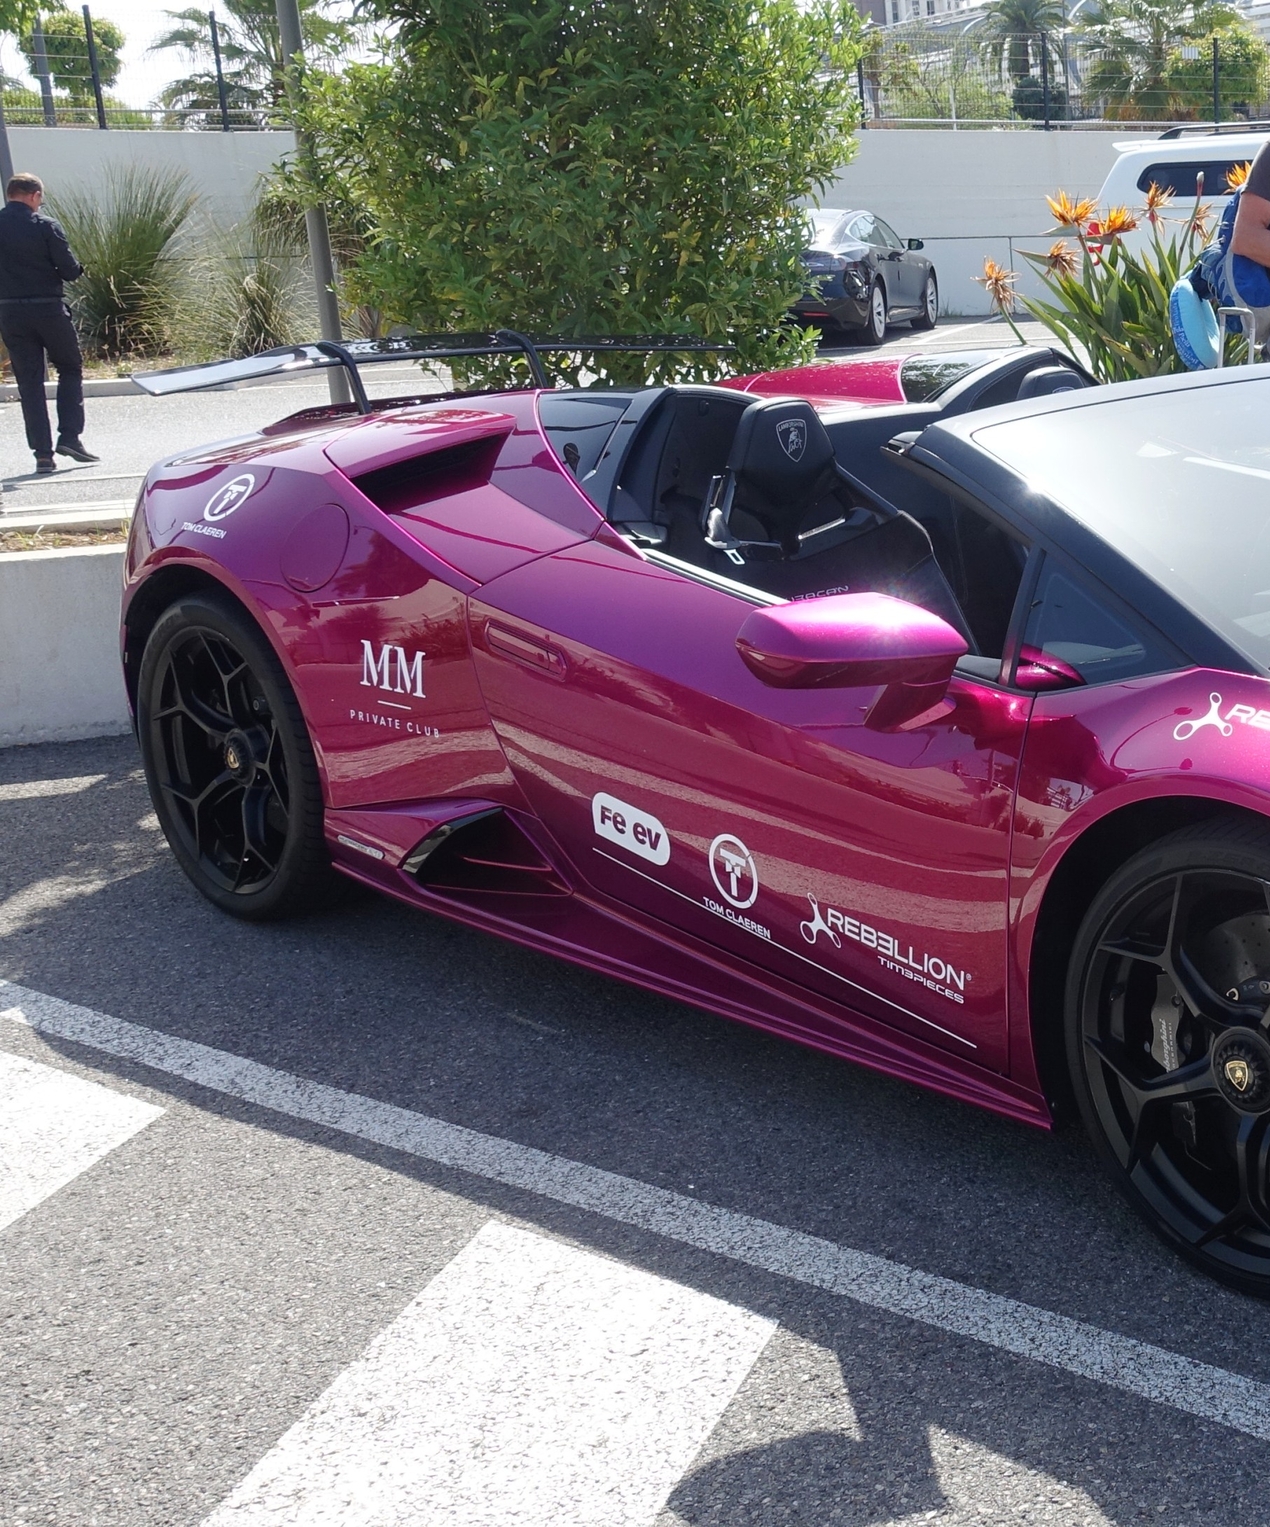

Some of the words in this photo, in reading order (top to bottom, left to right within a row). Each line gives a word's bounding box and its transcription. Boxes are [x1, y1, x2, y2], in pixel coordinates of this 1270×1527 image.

[180, 521, 195, 532] TOM
[194, 524, 227, 540] CLAEREN
[359, 639, 427, 699] MM
[349, 709, 401, 730] PRIVATE
[406, 722, 440, 739] CLUB
[632, 821, 662, 852] ev
[702, 896, 725, 916] TOM
[725, 908, 772, 941] CLAEREN
